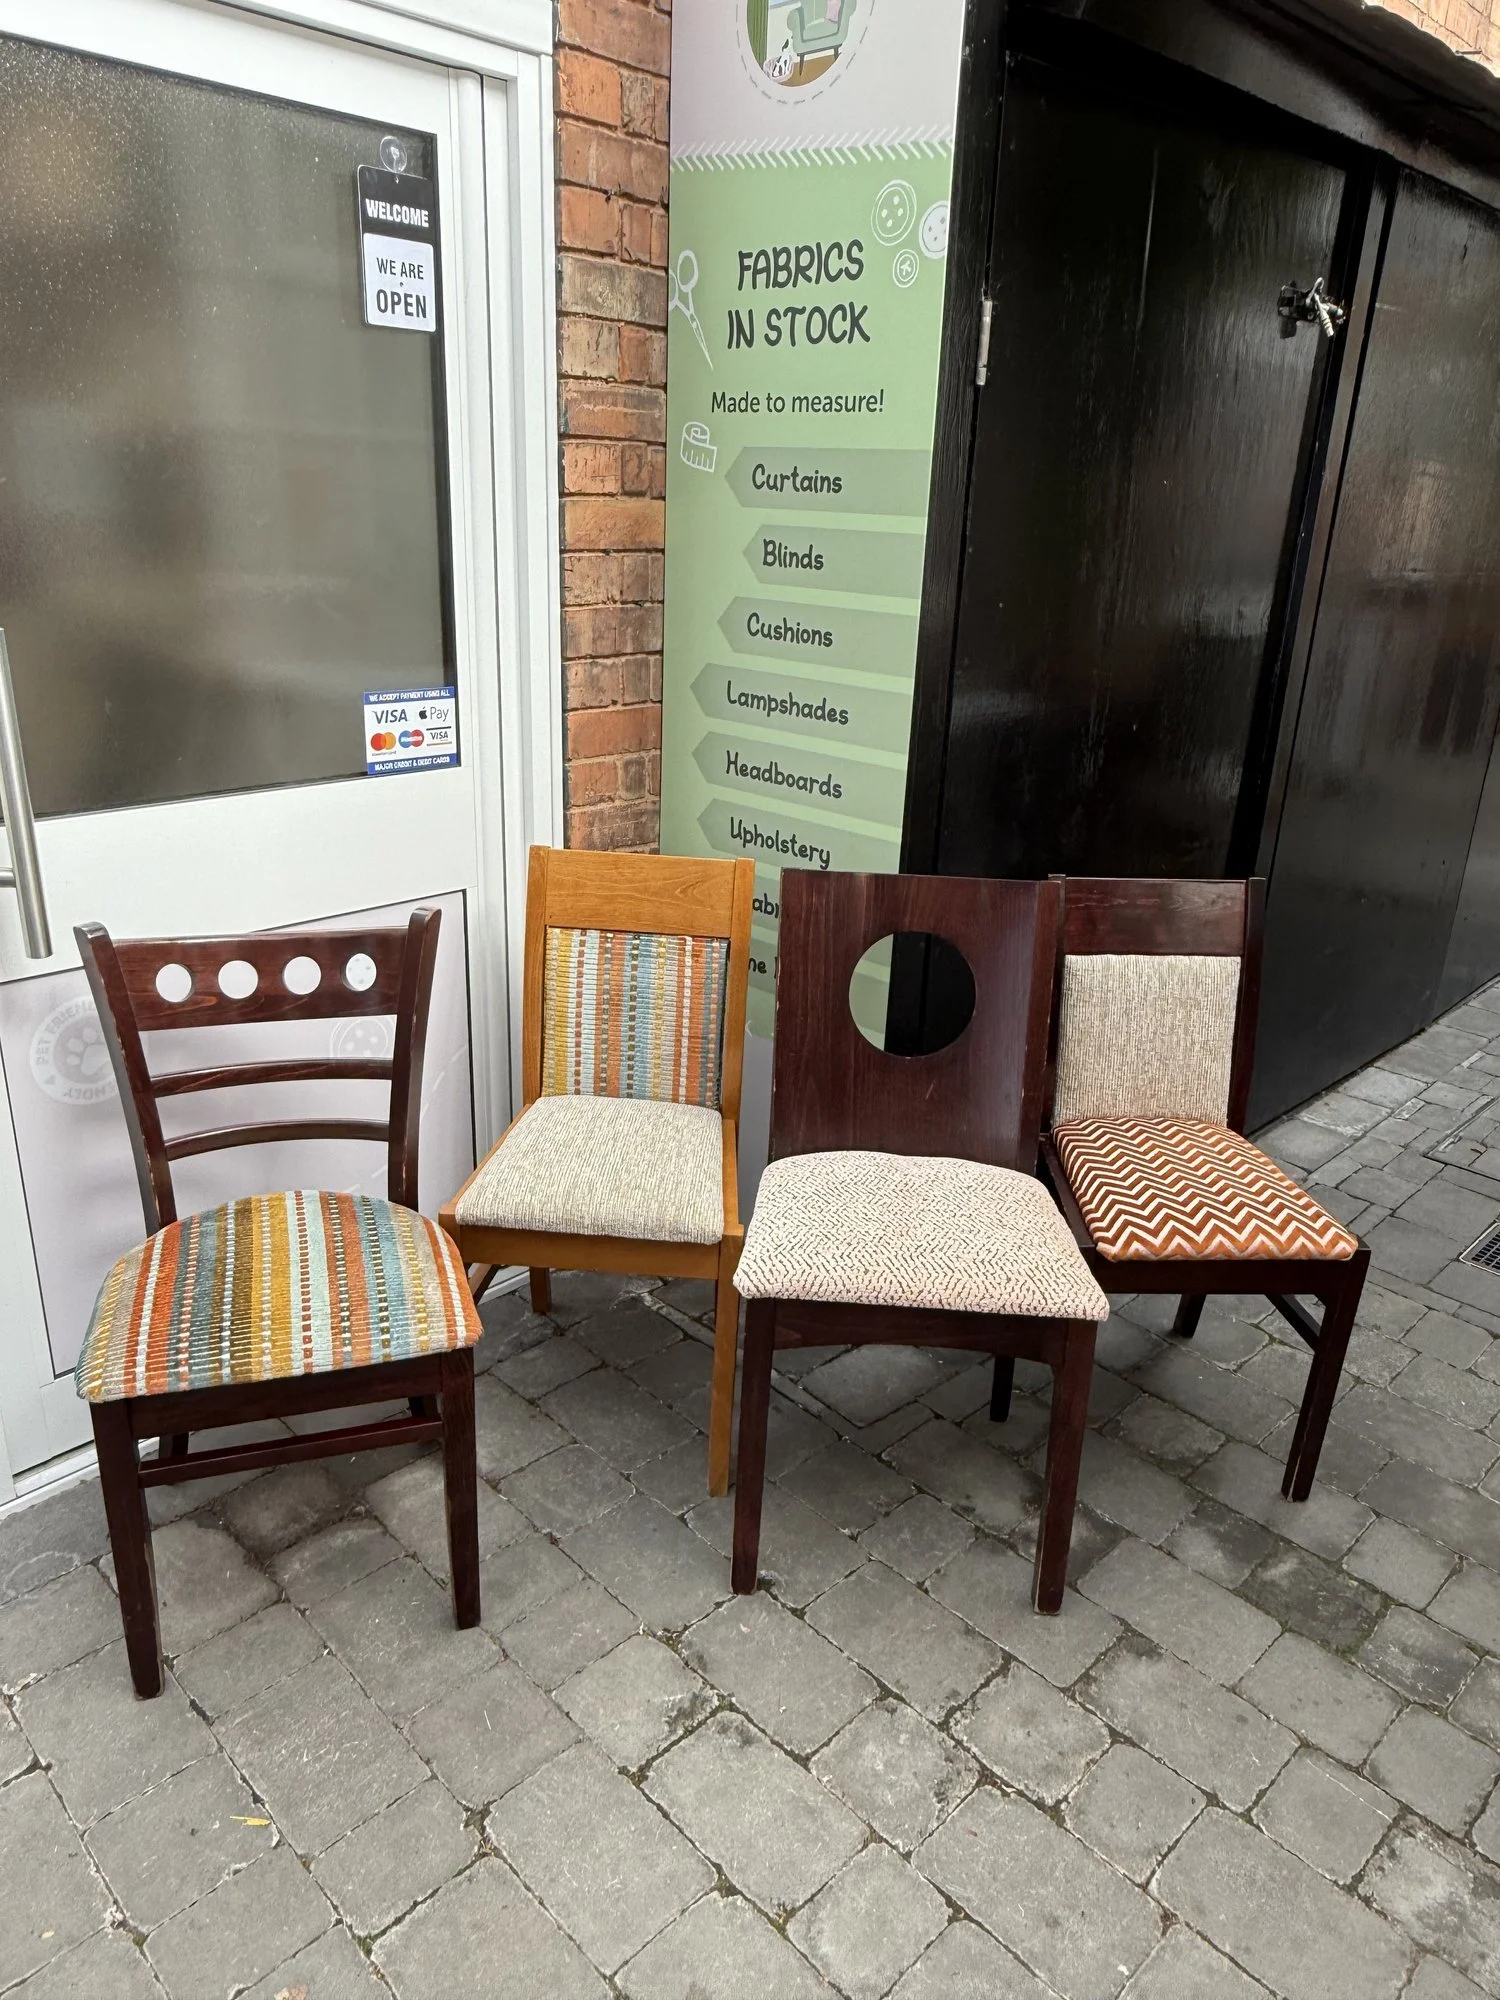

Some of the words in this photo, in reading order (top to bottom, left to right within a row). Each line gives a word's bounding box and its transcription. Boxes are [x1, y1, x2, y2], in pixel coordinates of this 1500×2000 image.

[365, 198, 430, 228] WELCOME
[376, 257, 397, 276] WE
[400, 261, 425, 280] ARE
[737, 239, 864, 291] FABRICS
[376, 288, 427, 319] OPEN
[727, 308, 755, 350] IN
[764, 301, 870, 347] STOCK
[711, 391, 760, 413] Made
[766, 393, 786, 413] to
[791, 389, 885, 413] measure!
[751, 463, 843, 494] Curtains
[762, 538, 825, 571] Blinds
[746, 612, 833, 648] Cushions
[379, 692, 400, 702] ACCEPT
[440, 689, 451, 697] ALL
[726, 680, 849, 726] Lampshades
[372, 708, 408, 724] VISA
[430, 706, 450, 722] Pay
[430, 731, 449, 740] VISA
[725, 750, 843, 799] Headboards
[729, 816, 831, 870] Upholstery
